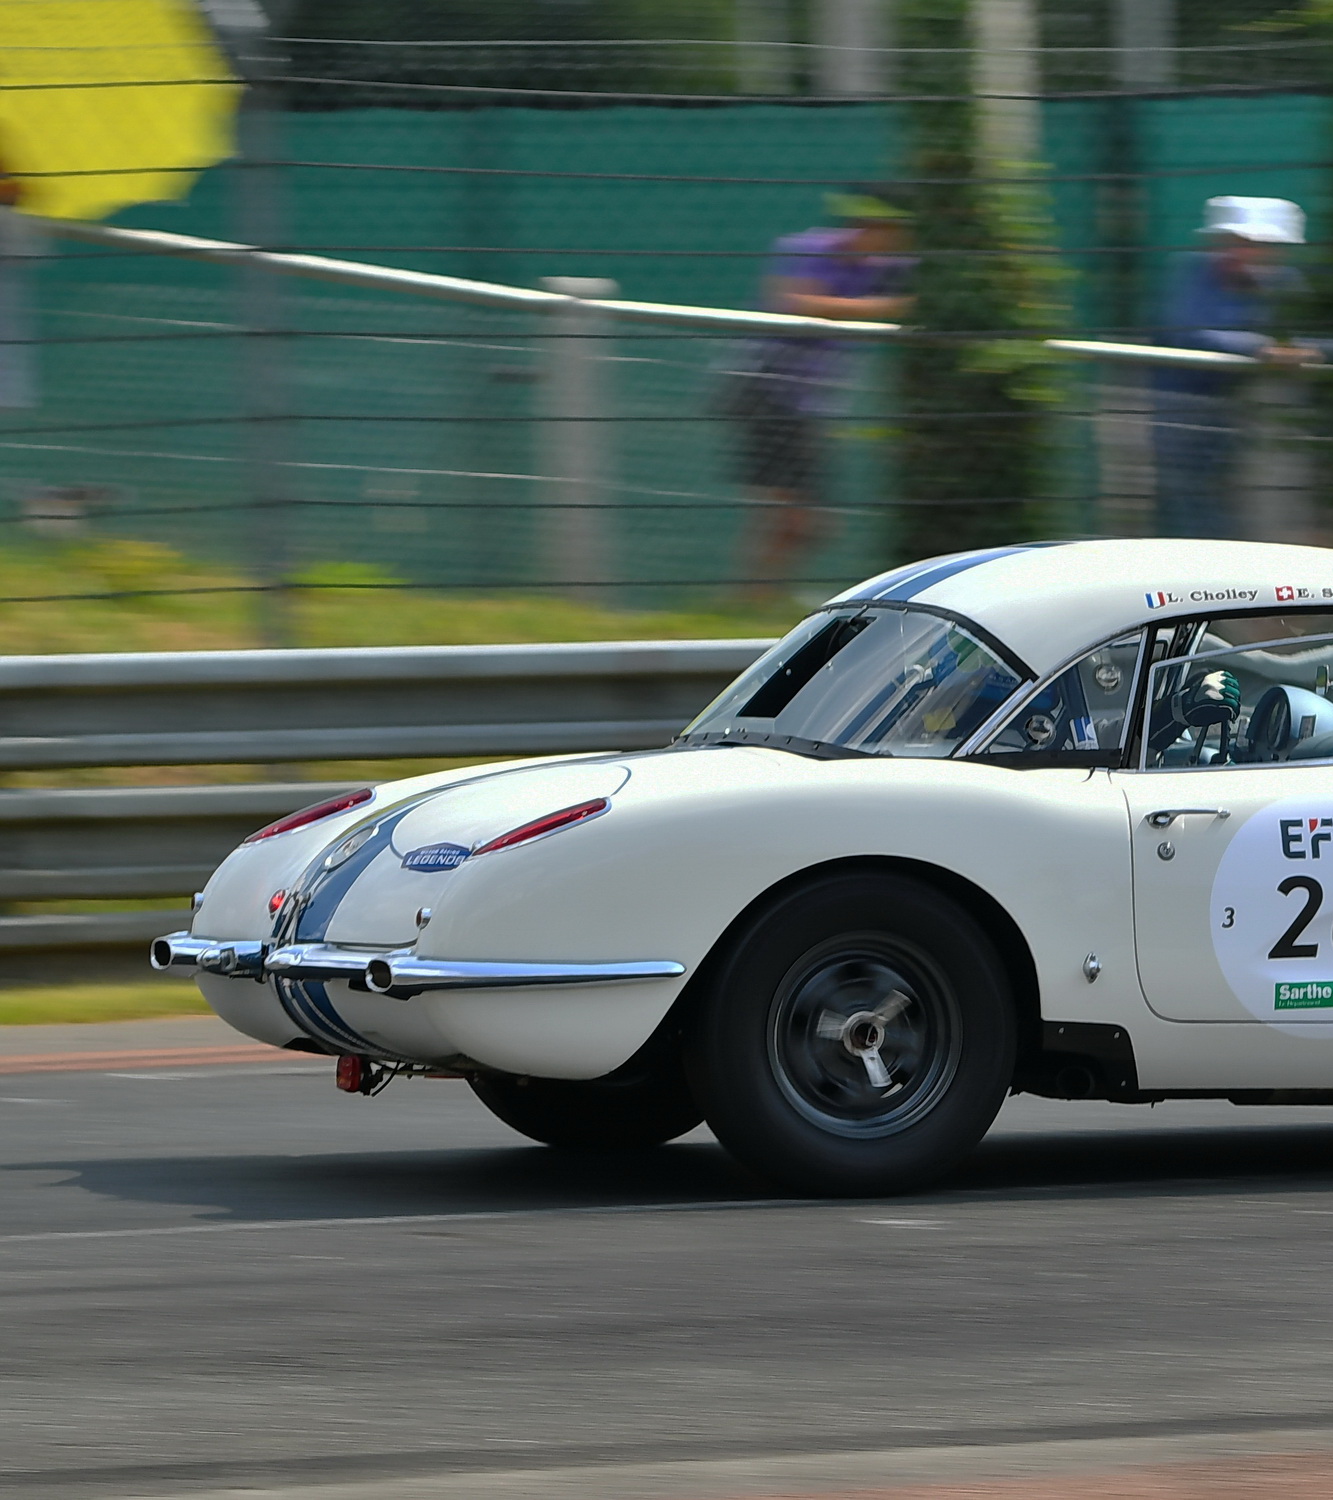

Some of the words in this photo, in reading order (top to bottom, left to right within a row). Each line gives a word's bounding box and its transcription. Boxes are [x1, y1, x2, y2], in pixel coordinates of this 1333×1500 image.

[1167, 593, 1183, 603] L.
[1190, 588, 1258, 602] Cholley
[1296, 588, 1315, 598] E.
[1221, 906, 1235, 928] 3
[1279, 984, 1332, 1000] Sarthe
